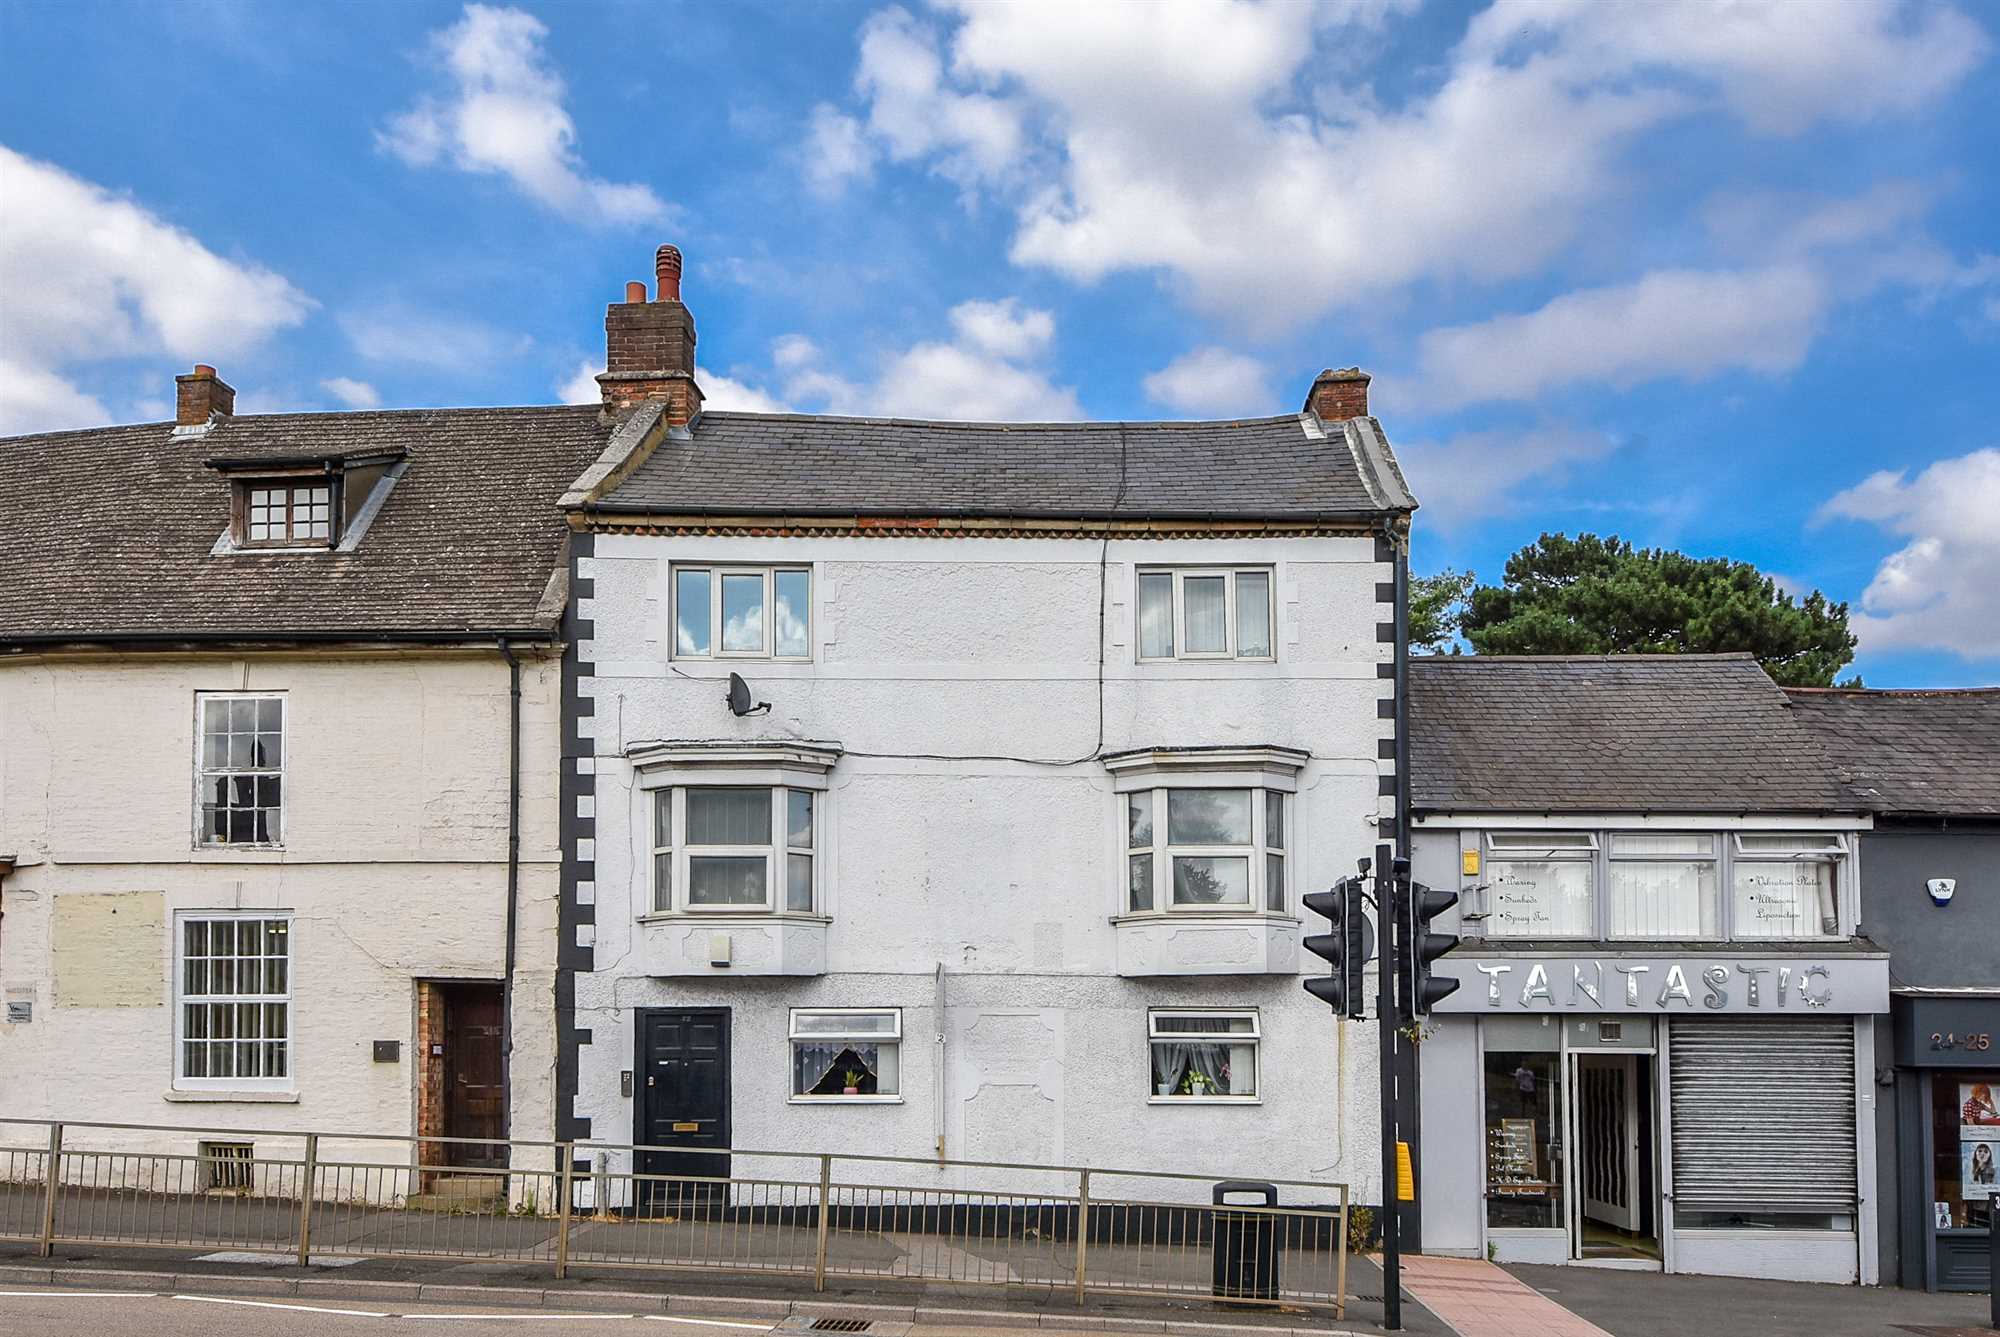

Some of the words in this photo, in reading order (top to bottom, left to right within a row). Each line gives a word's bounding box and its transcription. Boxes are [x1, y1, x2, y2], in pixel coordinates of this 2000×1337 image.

[1504, 911, 1530, 925] Spray
[1533, 911, 1551, 921] Tan
[1476, 960, 1832, 1010] TANTASTIC
